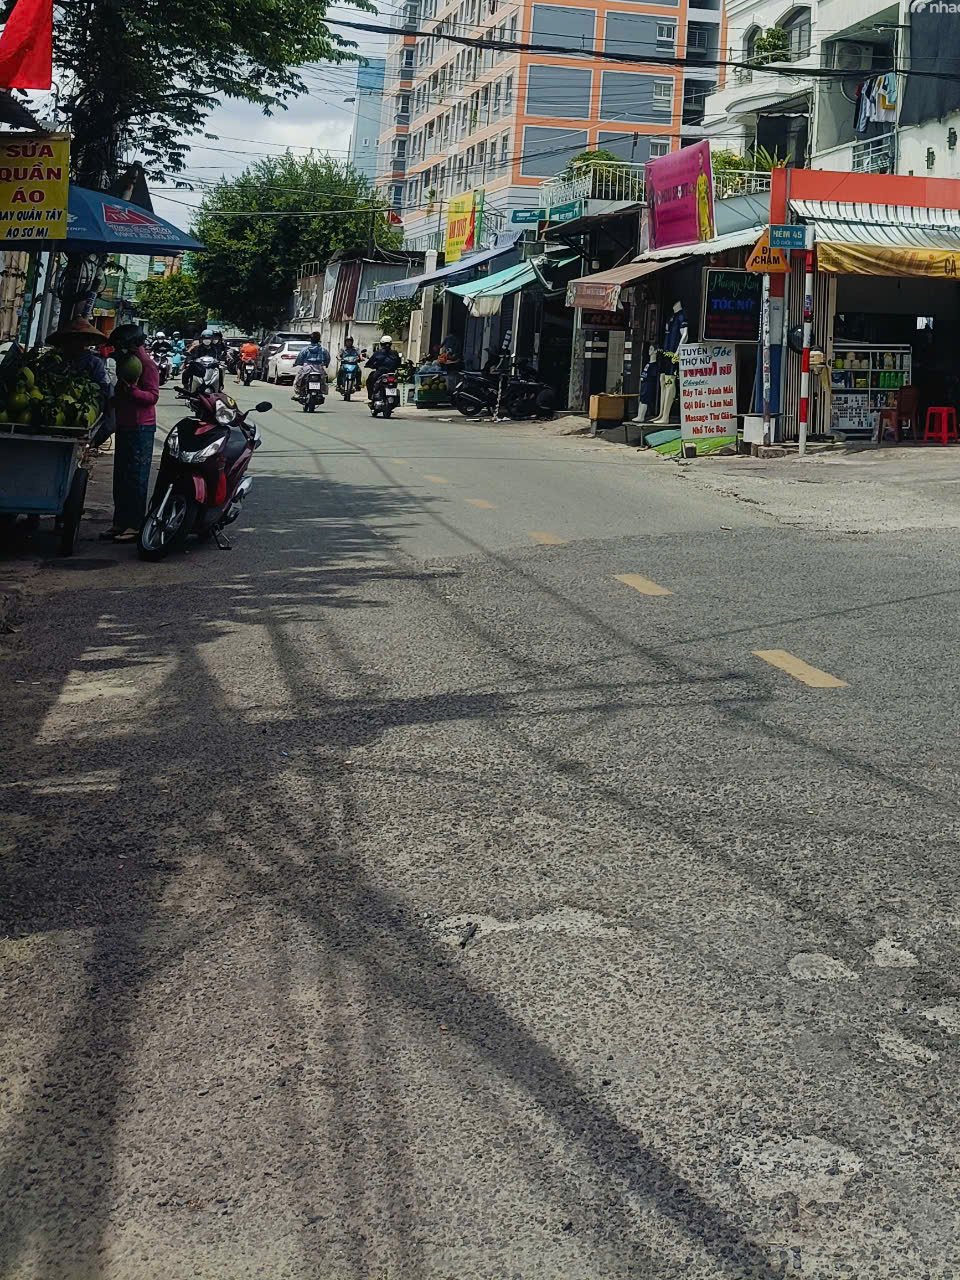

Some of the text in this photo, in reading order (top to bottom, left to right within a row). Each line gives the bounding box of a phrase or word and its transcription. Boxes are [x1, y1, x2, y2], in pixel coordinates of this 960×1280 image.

[6, 140, 54, 158] SỬA
[0, 162, 62, 182] QUẦN
[11, 187, 45, 203] ÁO
[45, 208, 62, 221] TÂY
[36, 227, 48, 237] MI
[792, 230, 802, 239] 45
[944, 254, 957, 276] CÀ
